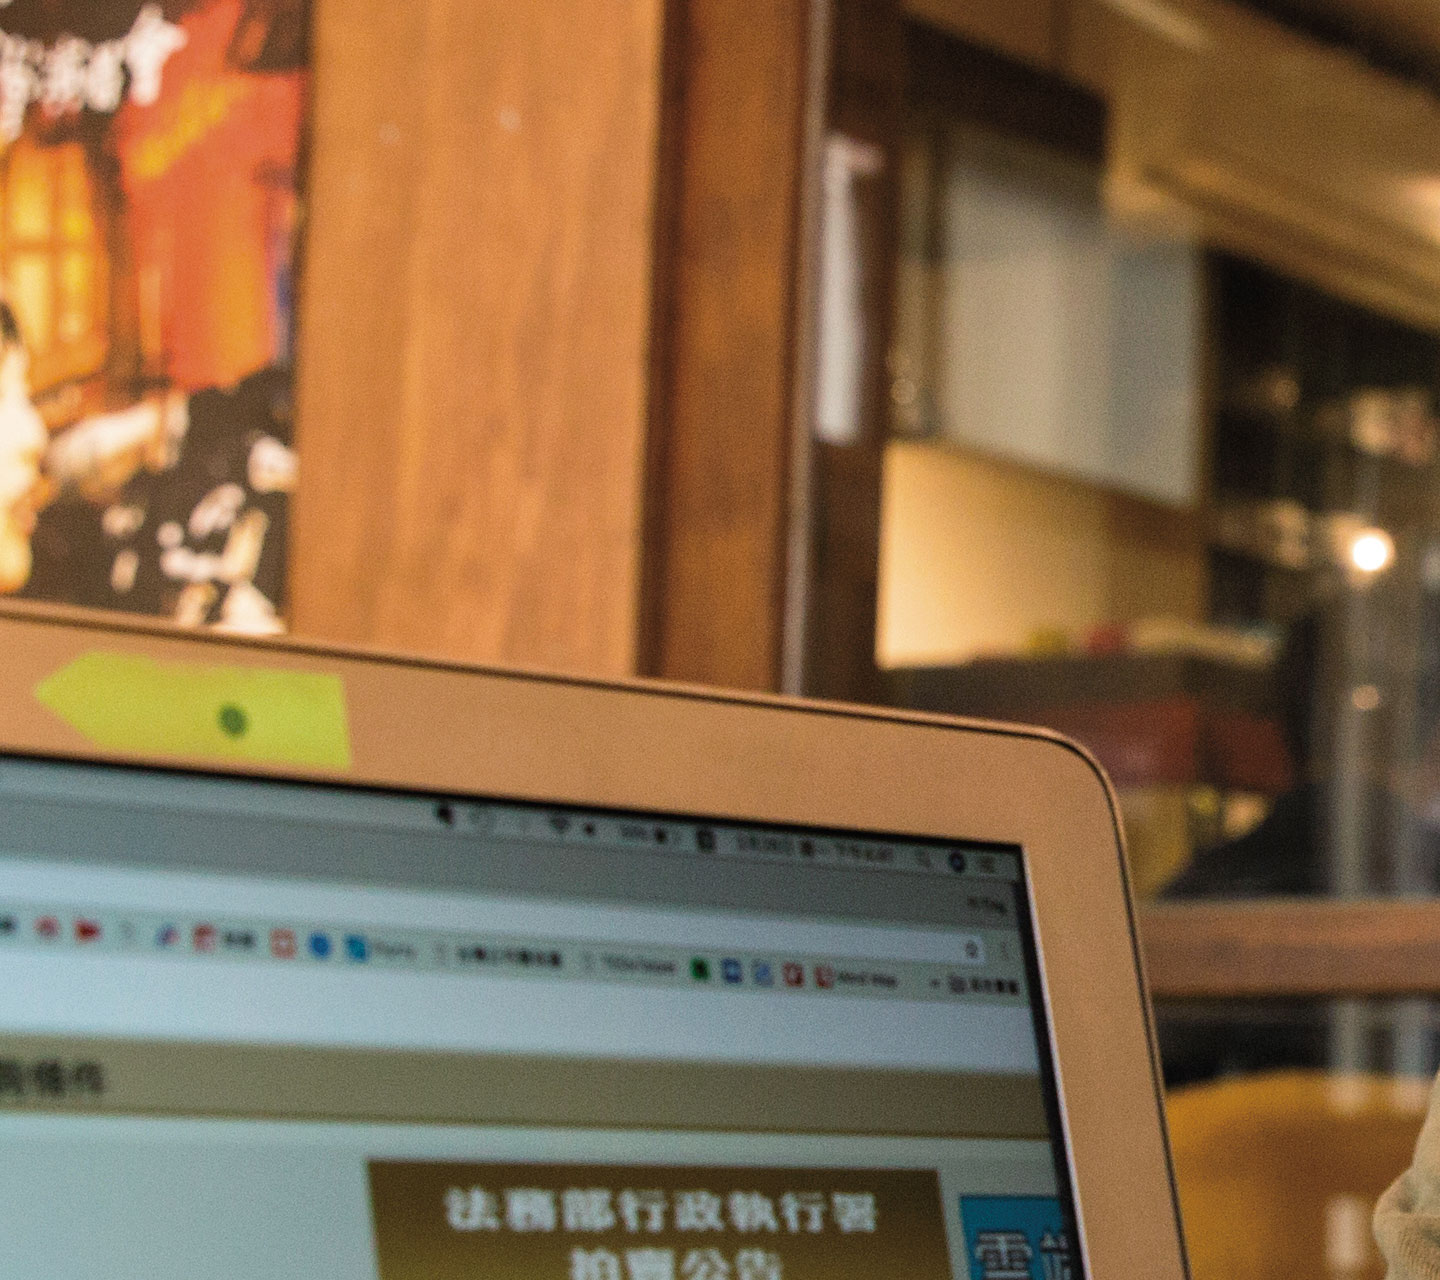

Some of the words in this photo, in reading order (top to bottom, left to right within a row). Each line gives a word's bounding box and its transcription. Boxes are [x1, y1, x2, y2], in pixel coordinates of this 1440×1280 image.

[444, 1187, 878, 1237] 法務部行政執行署
